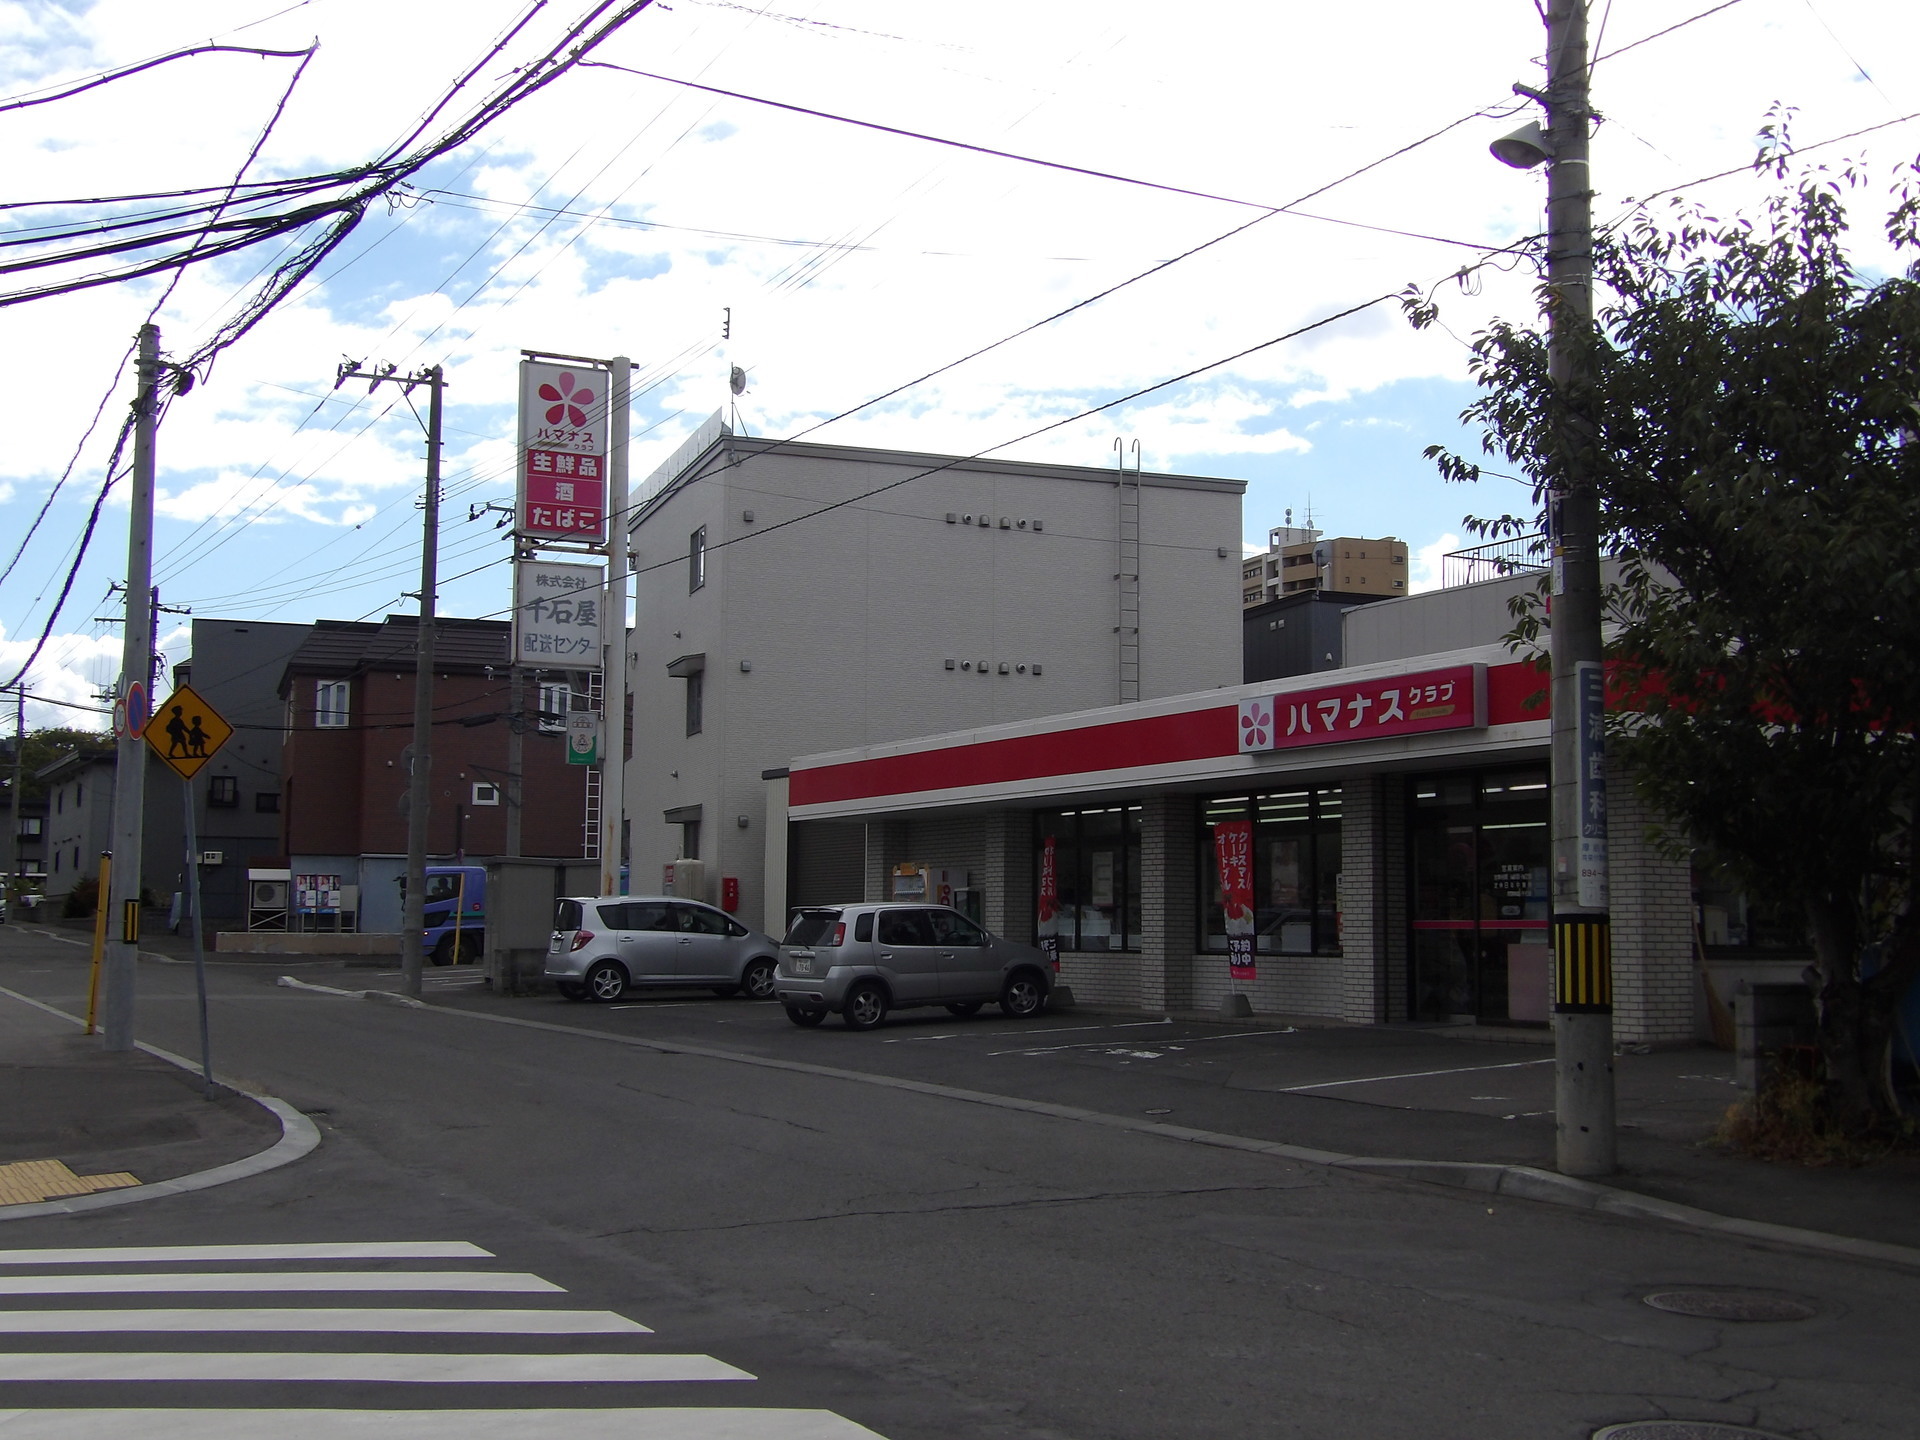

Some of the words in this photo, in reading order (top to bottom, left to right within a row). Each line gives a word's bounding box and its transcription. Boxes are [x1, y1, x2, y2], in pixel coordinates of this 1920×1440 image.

[537, 427, 594, 444] ハマナス
[533, 452, 597, 477] 生鮮品
[555, 482, 574, 502] 酒
[533, 507, 595, 530] たばこ
[536, 574, 587, 590] 株式会社
[525, 596, 598, 628] 千石屋
[524, 633, 597, 655] 配送センター
[1286, 689, 1404, 736] ハマナス
[1408, 680, 1455, 705] クラブ
[1217, 833, 1231, 891] オードブル
[1229, 832, 1238, 868] ケーキ
[1237, 831, 1248, 889] クリスマス
